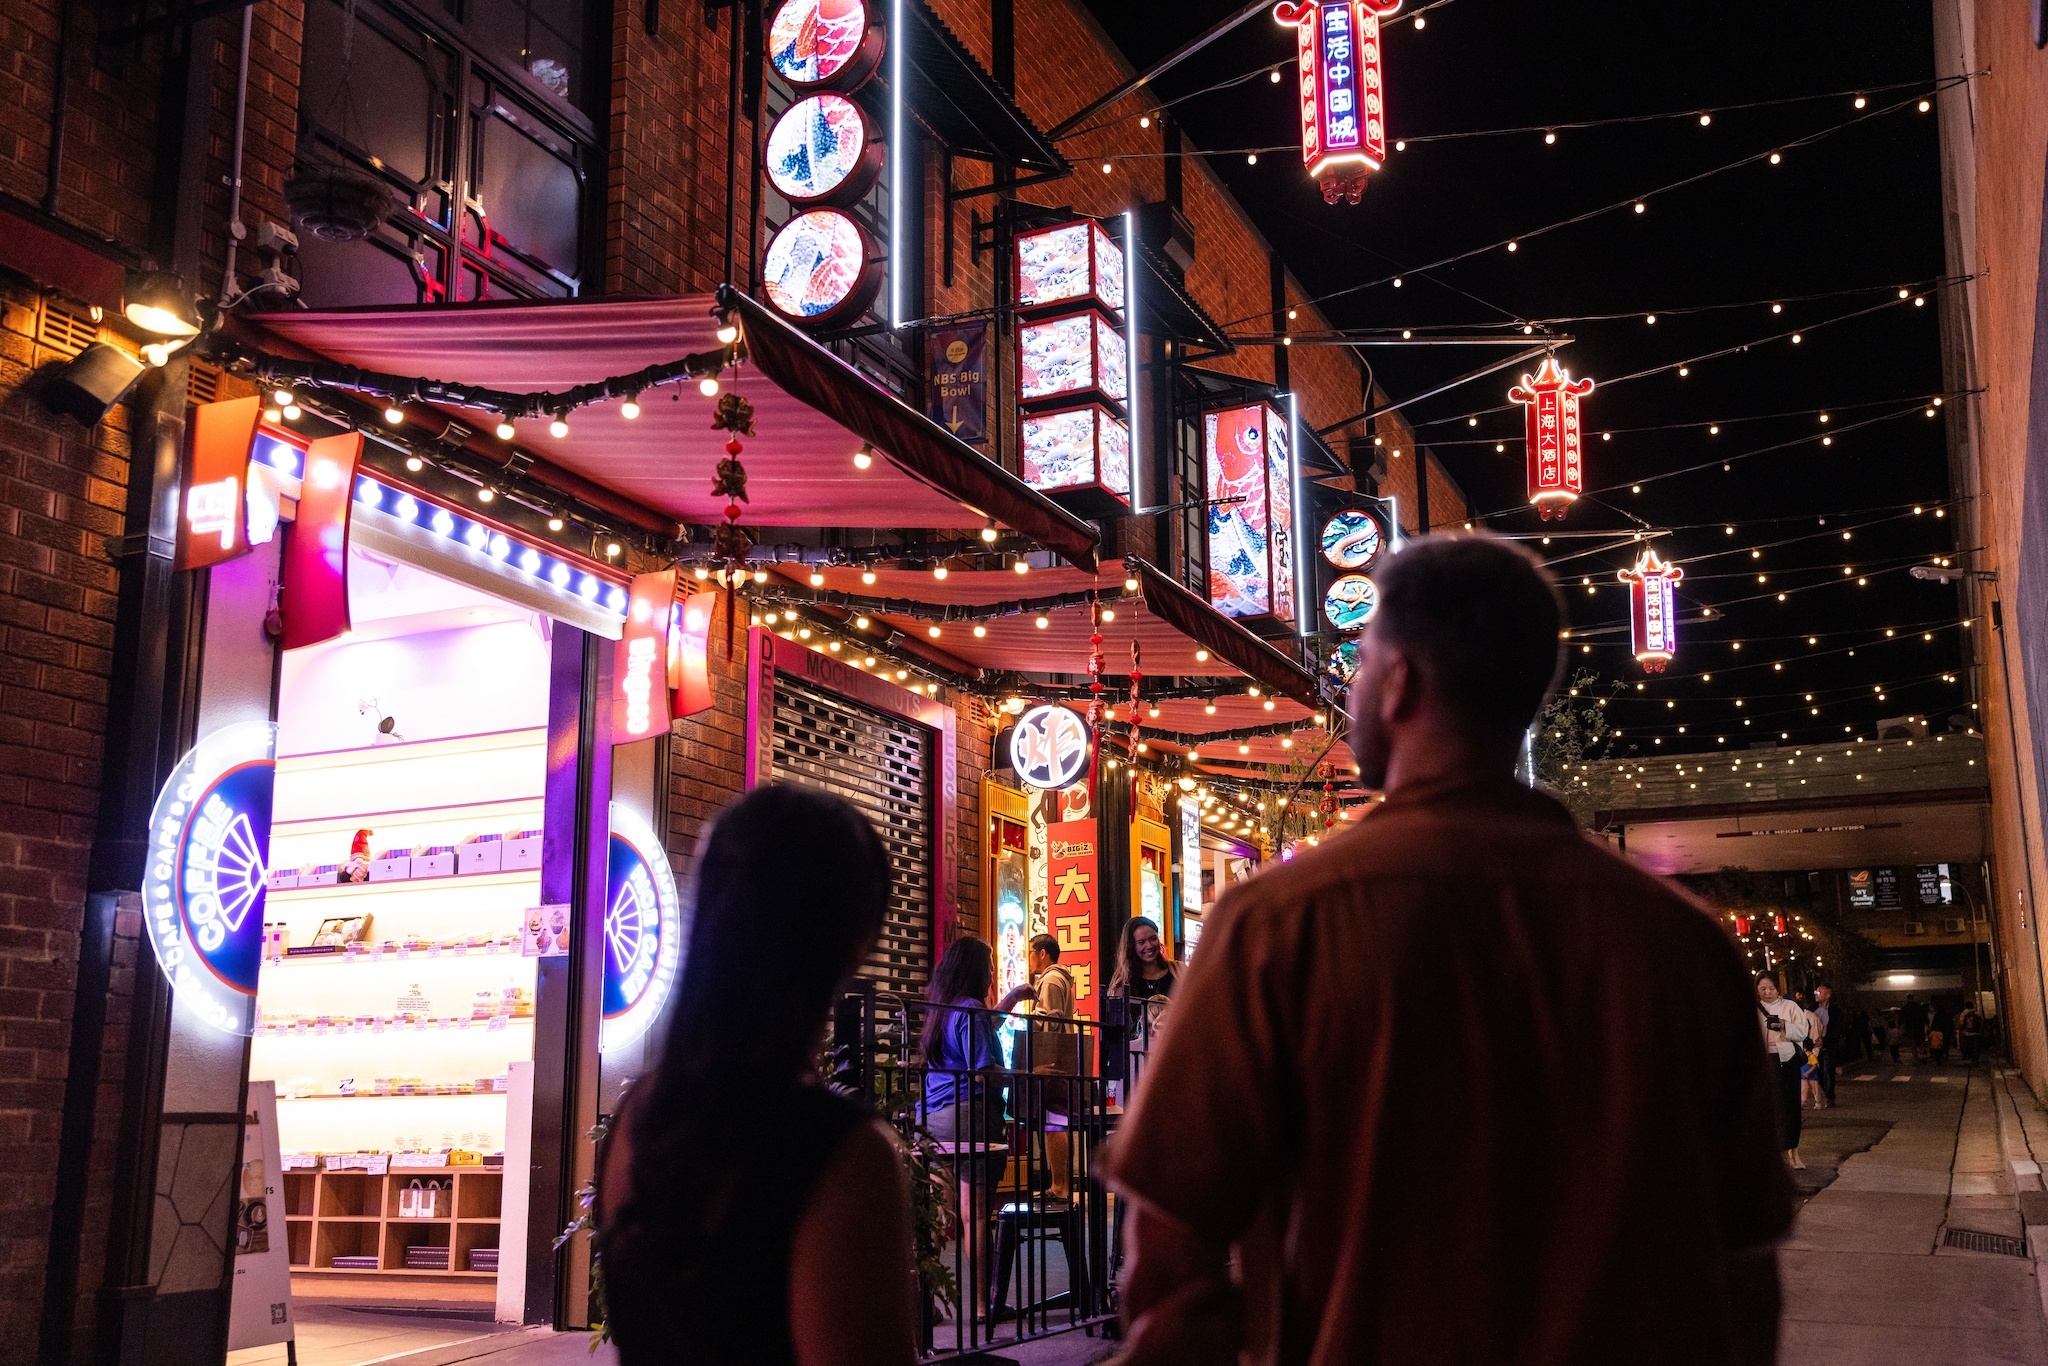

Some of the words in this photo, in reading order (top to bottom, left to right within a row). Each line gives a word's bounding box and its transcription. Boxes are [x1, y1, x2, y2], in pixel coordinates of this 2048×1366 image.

[934, 373, 957, 386] NBS
[960, 370, 980, 383] Big
[941, 384, 971, 397] Bowl
[1540, 397, 1557, 481] 上海大酒店
[806, 651, 858, 693] MOCHI
[759, 634, 773, 787] DESSE
[154, 813, 182, 880] CAFE
[186, 793, 233, 951] COFFEE
[630, 864, 659, 926] RICE
[155, 902, 184, 966] CAFE
[621, 933, 657, 1004] CAKE
